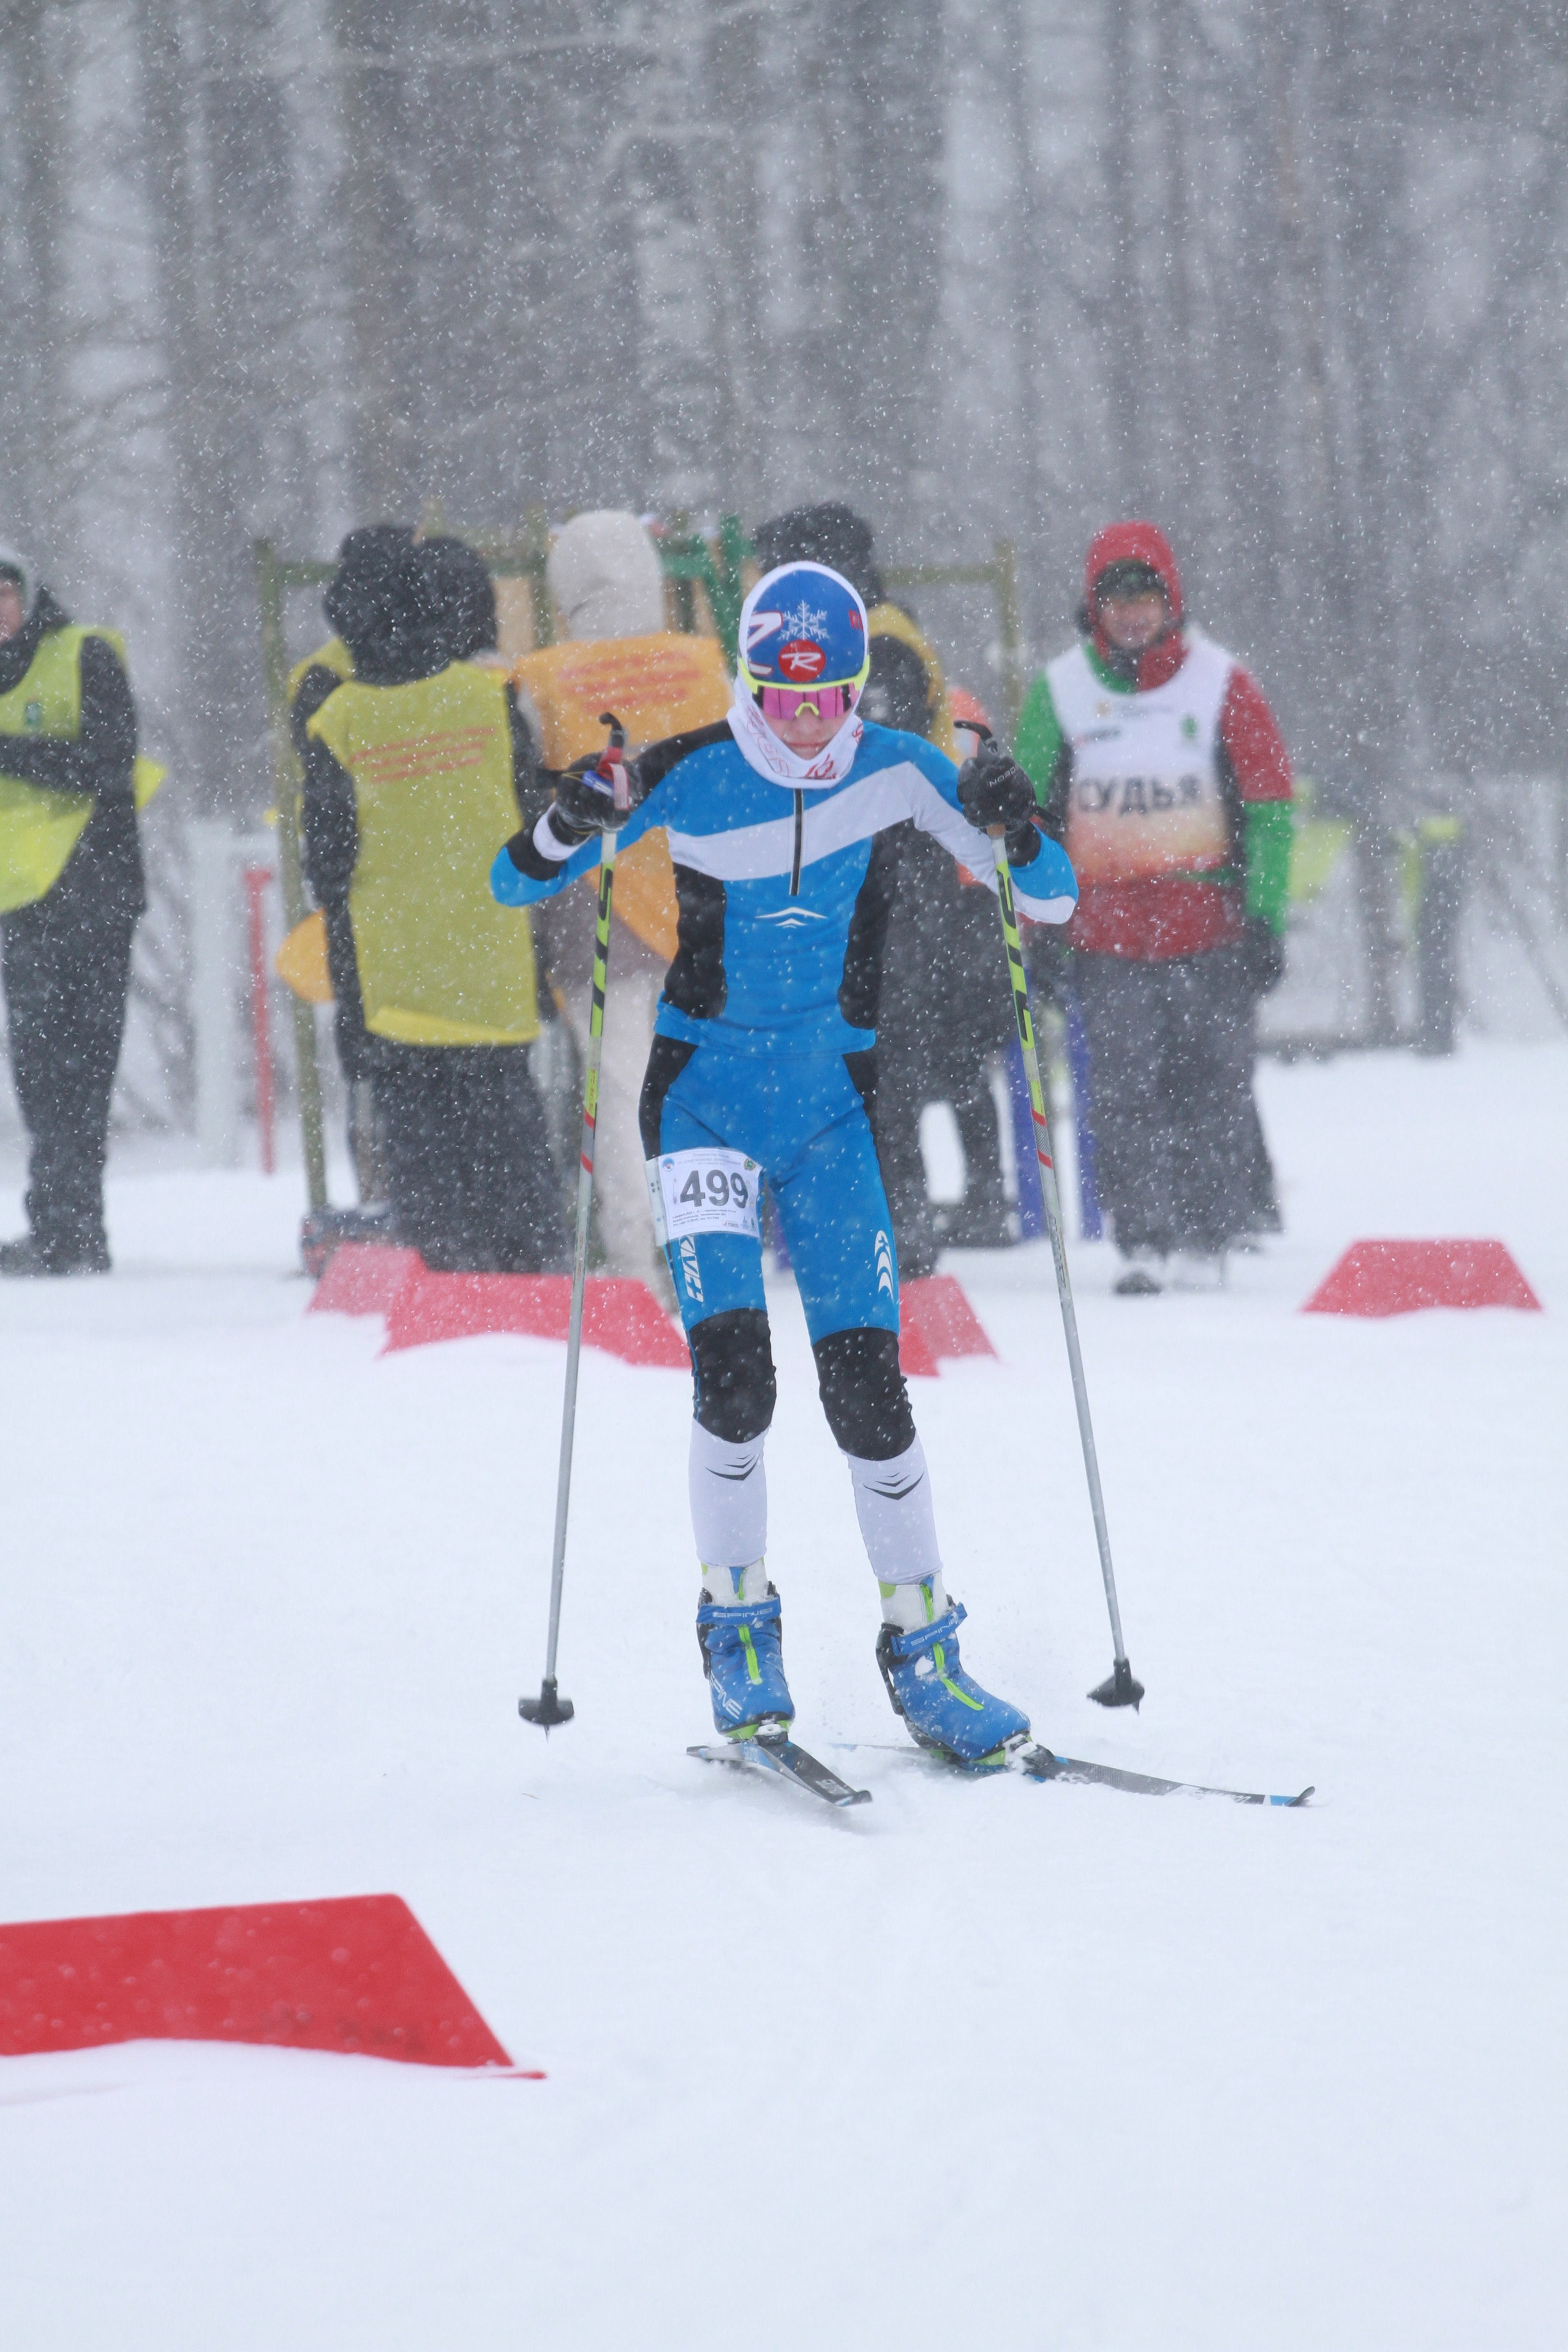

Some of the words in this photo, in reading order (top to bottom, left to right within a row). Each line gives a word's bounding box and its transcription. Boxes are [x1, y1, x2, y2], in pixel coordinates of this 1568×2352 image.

[1078, 776, 1200, 816] СУДЬЯ
[680, 1169, 748, 1208] 499
[712, 1607, 772, 1618] SPINE
